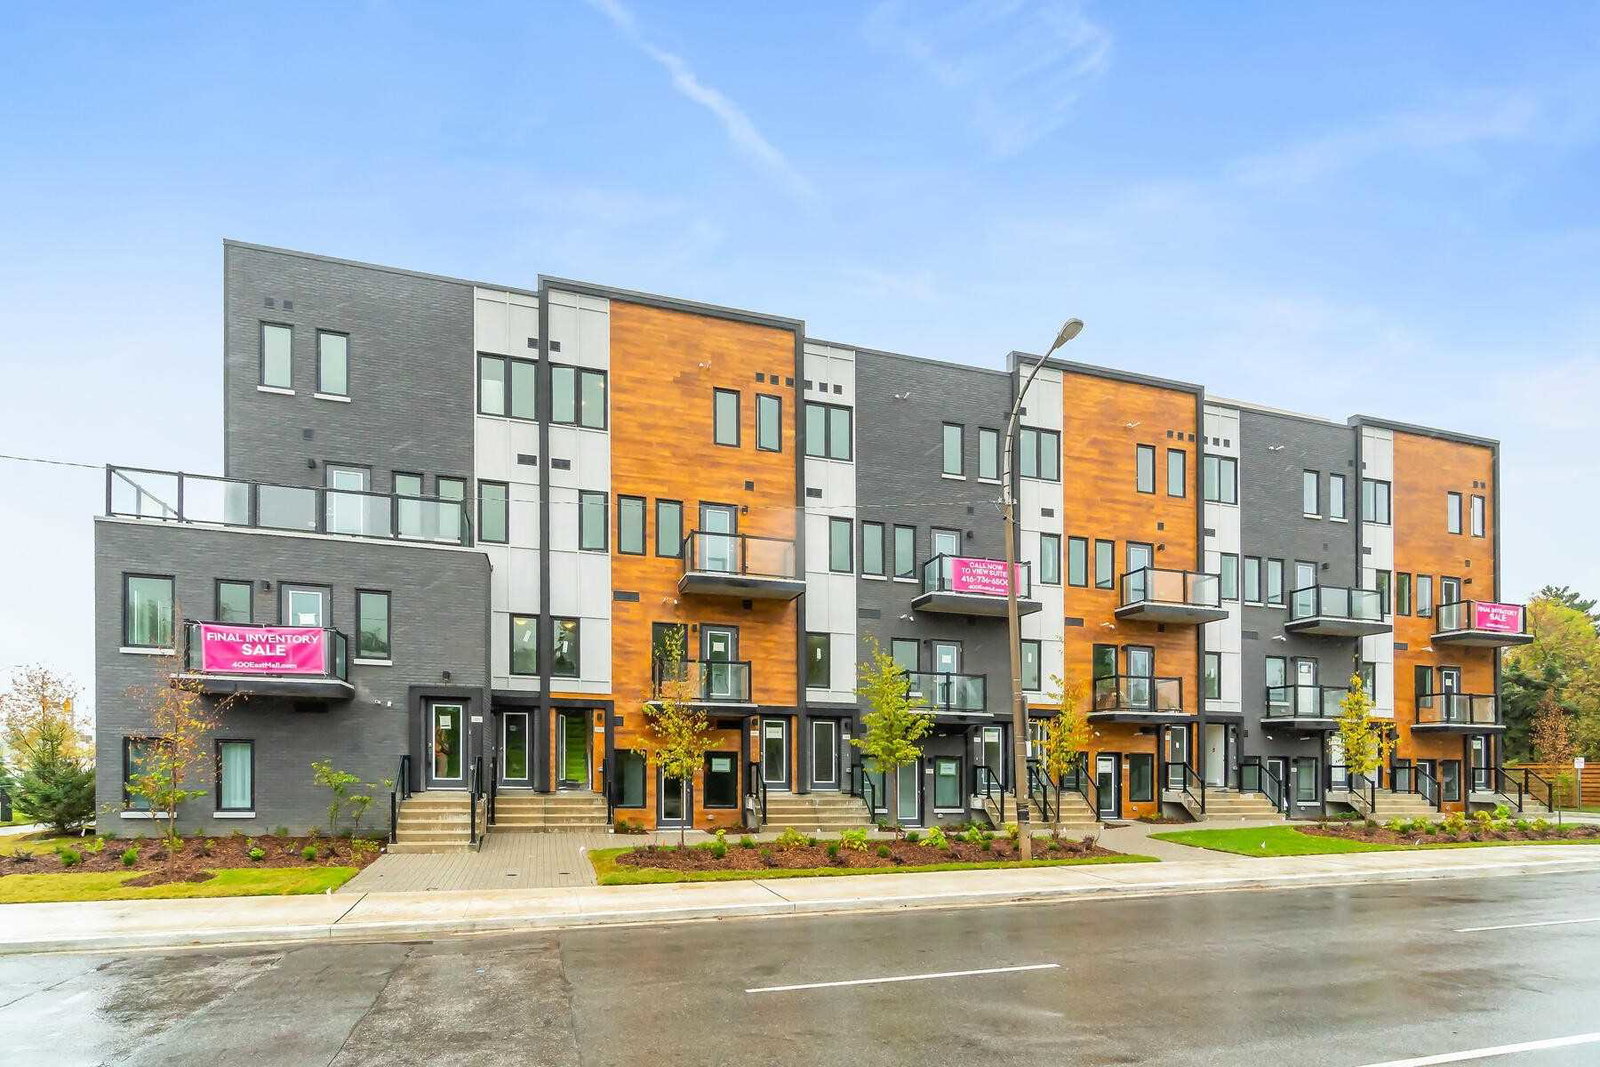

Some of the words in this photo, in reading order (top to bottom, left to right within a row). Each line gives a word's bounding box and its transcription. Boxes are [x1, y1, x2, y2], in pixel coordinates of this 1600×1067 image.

[1489, 613, 1507, 622] SALE
[206, 632, 242, 643] FINAL
[246, 633, 320, 644] INVENTORY
[241, 644, 286, 656] SALE
[232, 660, 297, 669] 400EastMall.com
